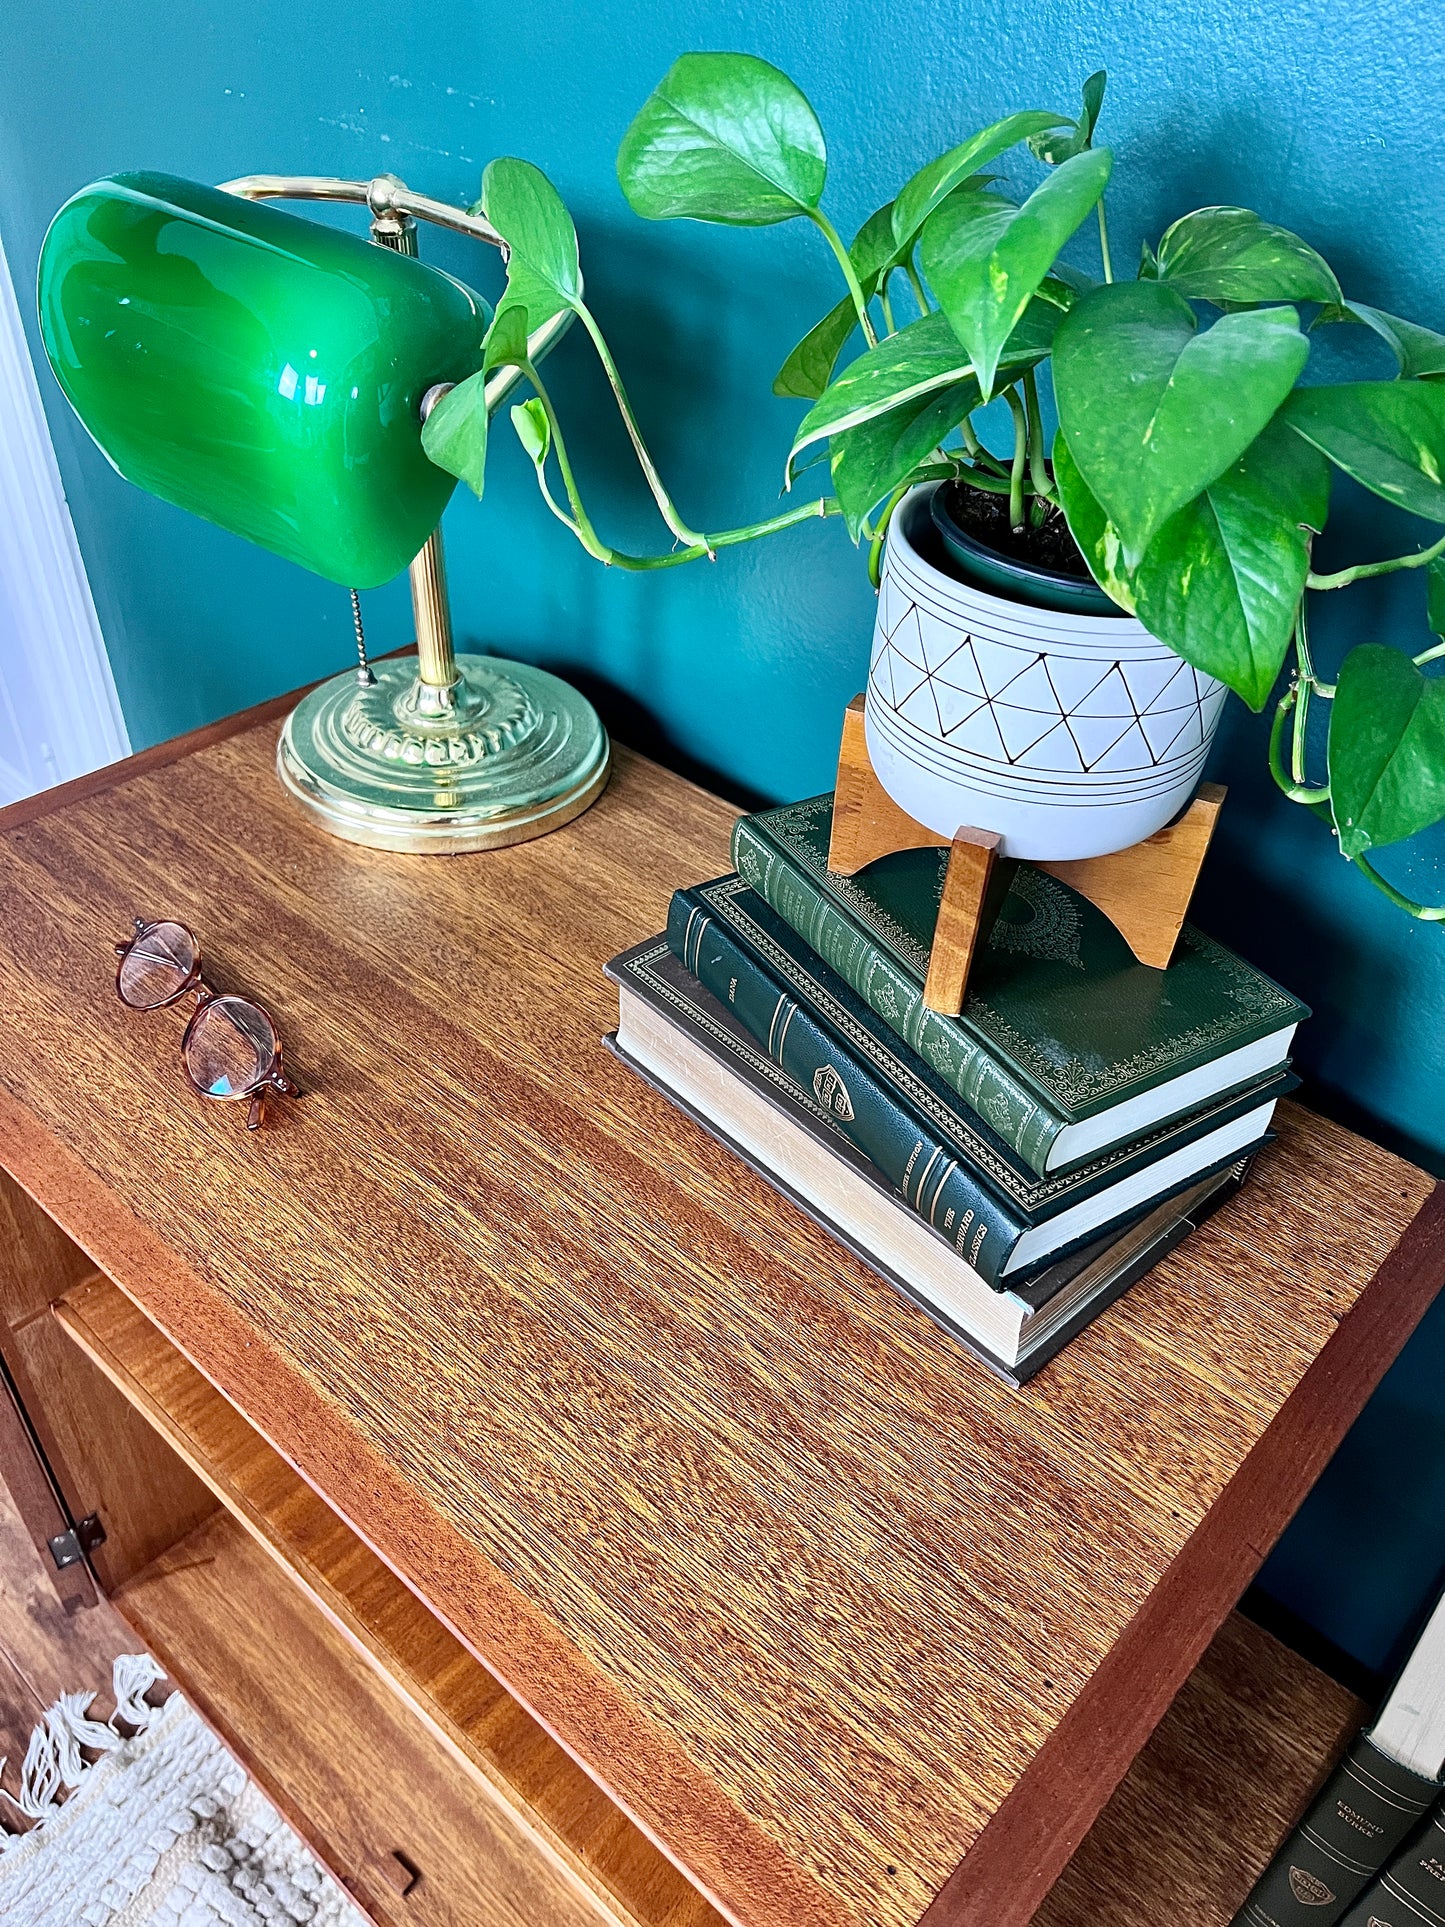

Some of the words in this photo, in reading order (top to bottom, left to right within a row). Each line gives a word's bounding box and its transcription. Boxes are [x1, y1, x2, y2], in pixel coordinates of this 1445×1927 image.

[907, 1140, 924, 1176] EDITION
[944, 1207, 956, 1229] THE
[956, 1209, 975, 1255] HARVARD
[968, 1223, 988, 1267] CLASSICS
[1336, 1800, 1384, 1834] EDMUND
[1337, 1809, 1374, 1838] BURKE
